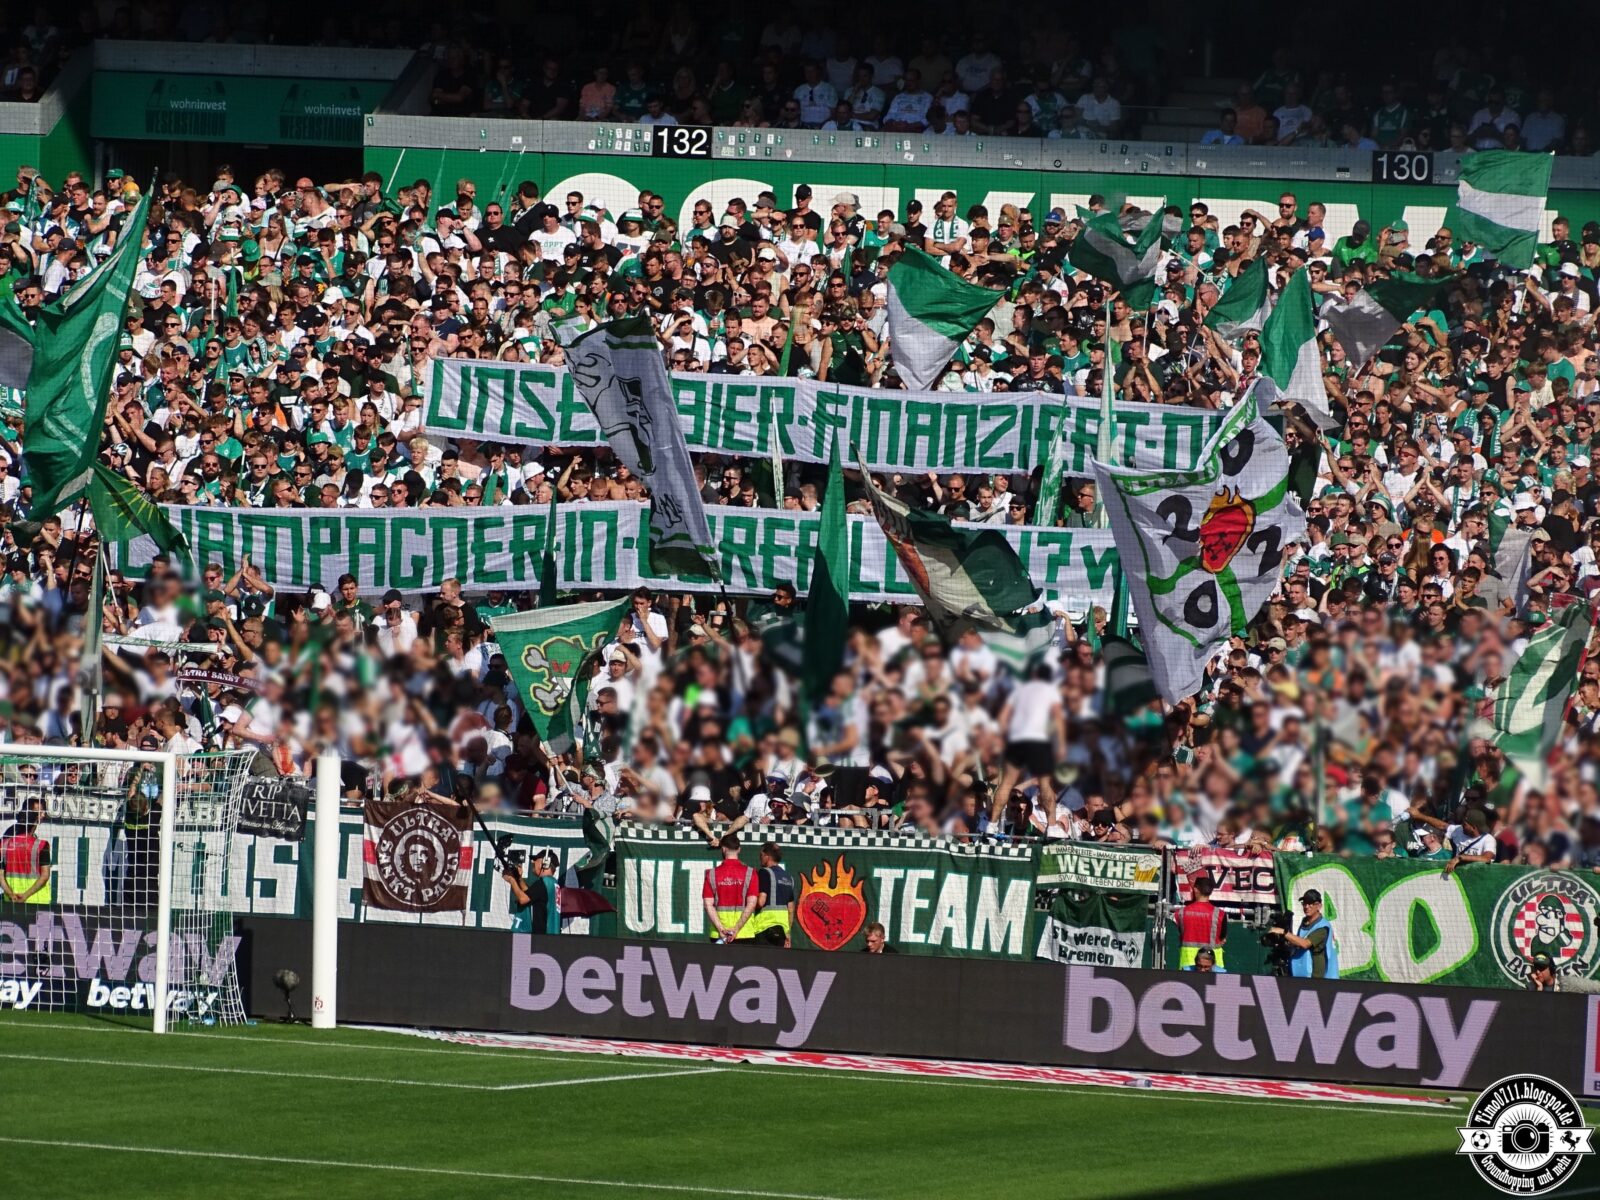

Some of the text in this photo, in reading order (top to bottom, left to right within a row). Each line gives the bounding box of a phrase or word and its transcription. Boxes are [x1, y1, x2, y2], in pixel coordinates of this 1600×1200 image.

[170, 98, 226, 111] wohninvest
[304, 104, 361, 116] wohninvest
[657, 128, 708, 155] 132
[1378, 153, 1428, 181] 130
[425, 358, 610, 446] UNSE
[252, 784, 282, 800] RIP
[378, 839, 416, 901] SANKT
[421, 853, 459, 902] PAULI
[1057, 854, 1137, 881] WEYHE
[873, 867, 1032, 955] TEAM
[1073, 931, 1127, 951] Werder
[1058, 945, 1114, 965] Bremen
[510, 933, 837, 1048] betway
[1063, 965, 1501, 1088] betway
